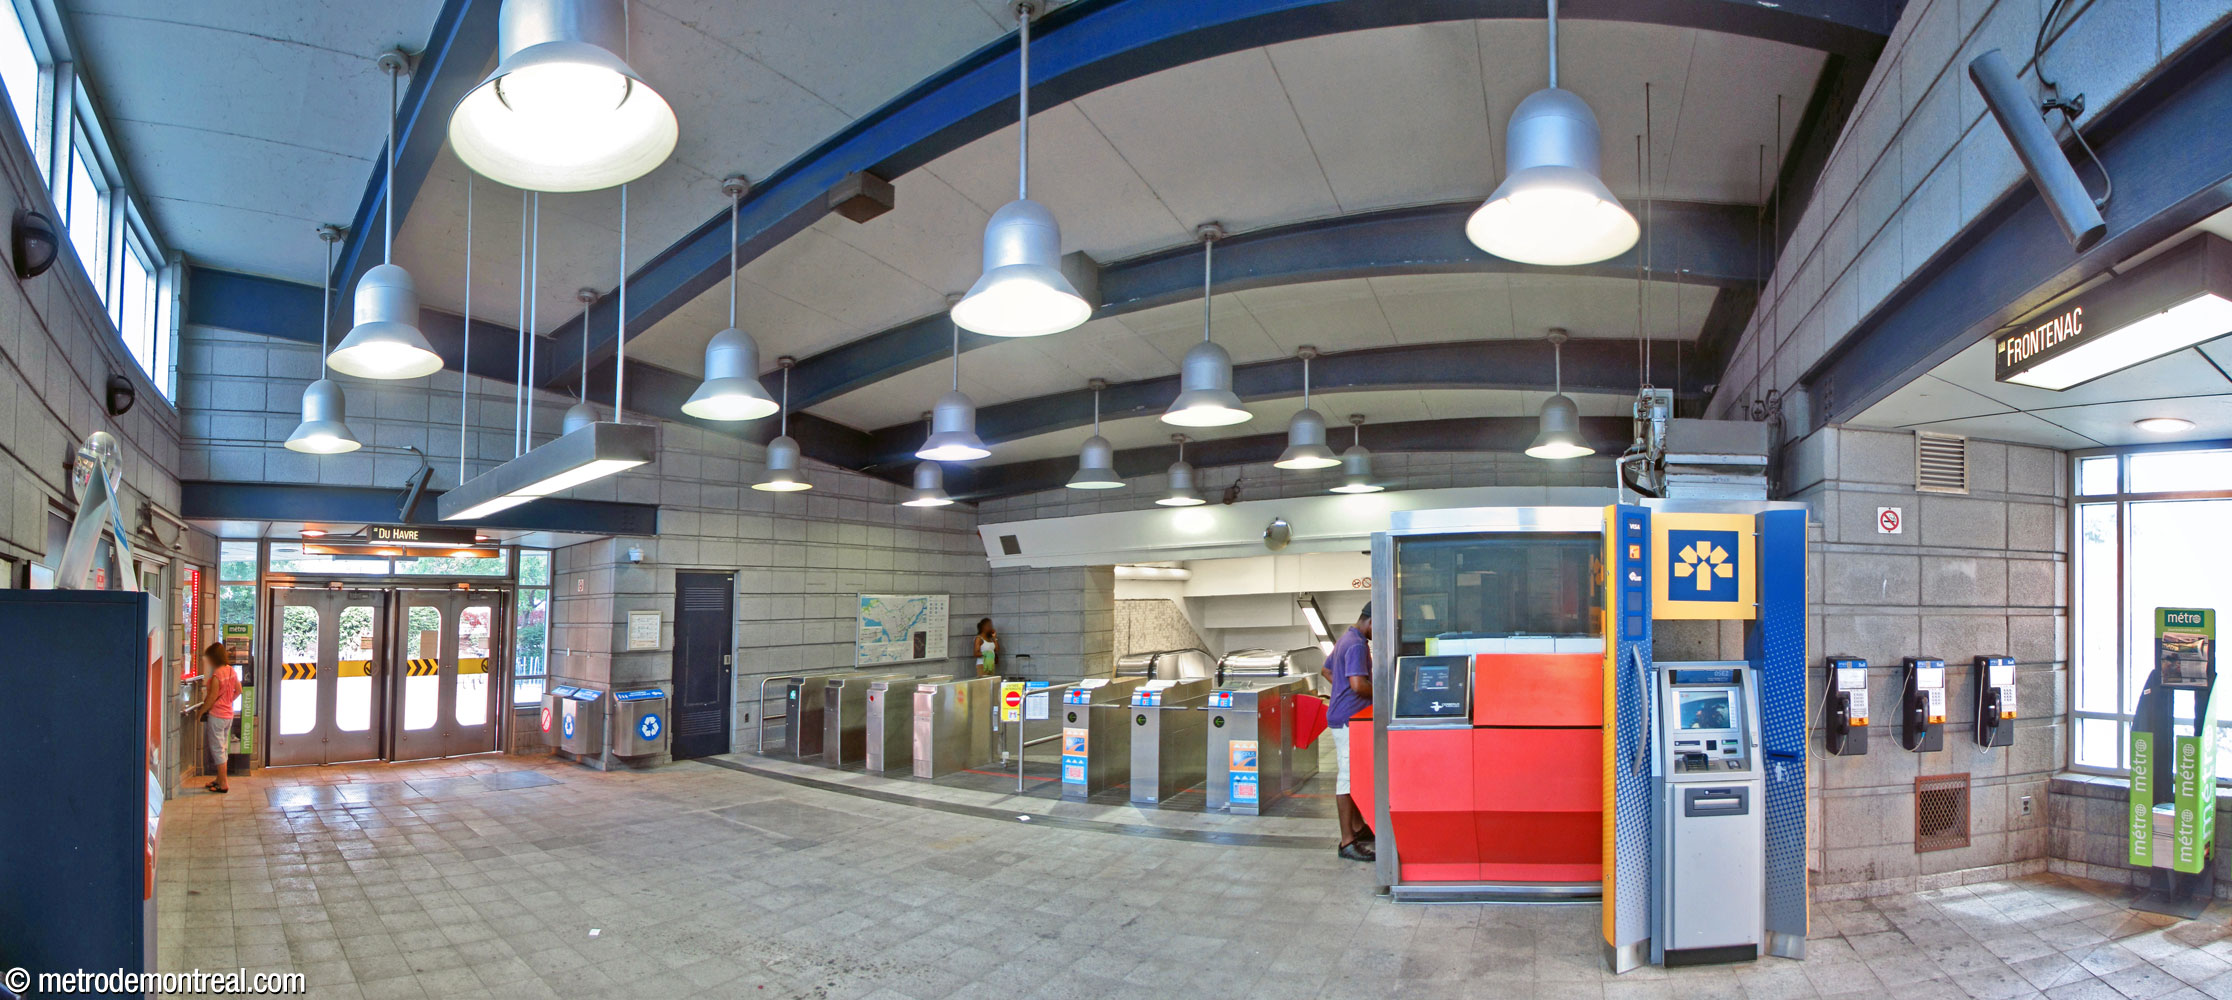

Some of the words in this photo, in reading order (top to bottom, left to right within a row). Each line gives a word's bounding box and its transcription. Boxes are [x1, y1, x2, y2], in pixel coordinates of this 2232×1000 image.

[2006, 306, 2083, 367] FRONTENAC
[393, 528, 419, 540] HAVRE
[2167, 612, 2202, 624] métro
[2132, 738, 2147, 792] métro
[2179, 743, 2196, 797] métro
[2132, 803, 2147, 856] métro
[2178, 808, 2194, 863] métro
